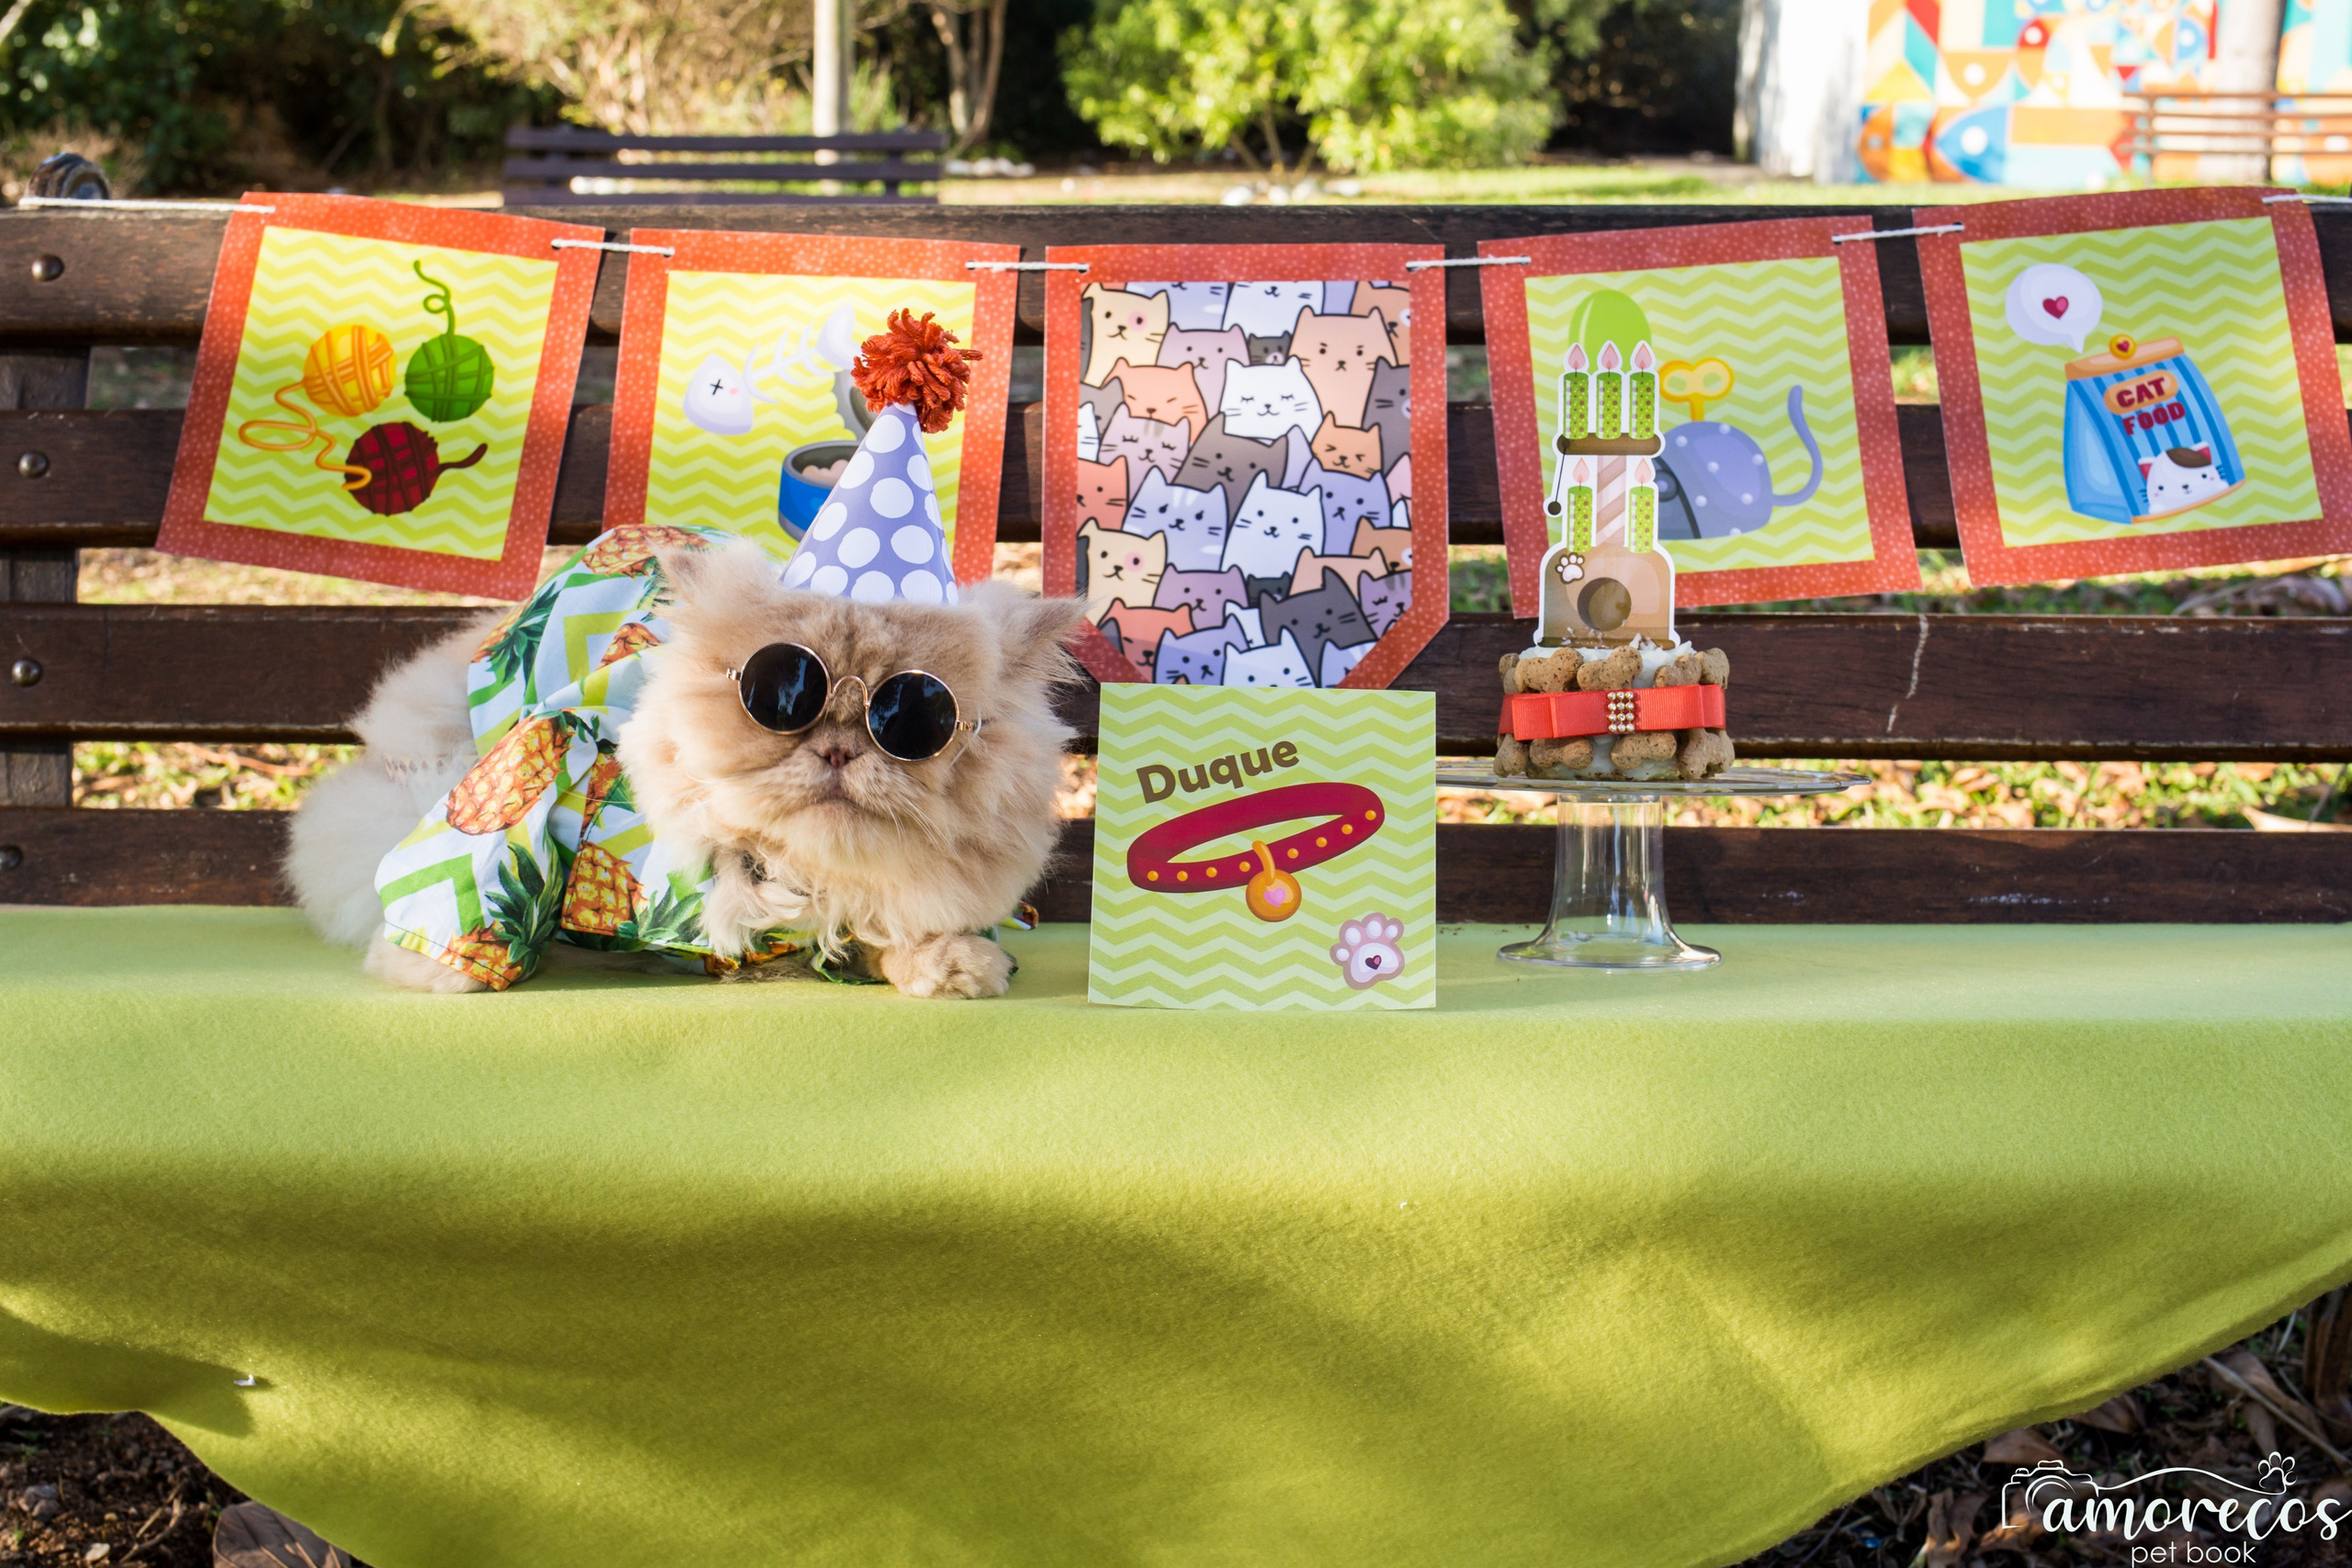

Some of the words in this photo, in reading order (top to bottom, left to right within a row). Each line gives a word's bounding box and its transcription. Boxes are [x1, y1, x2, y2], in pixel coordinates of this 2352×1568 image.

[2117, 377, 2165, 408] CAT
[2122, 401, 2186, 436] FOOD
[1136, 740, 1300, 804] Duque
